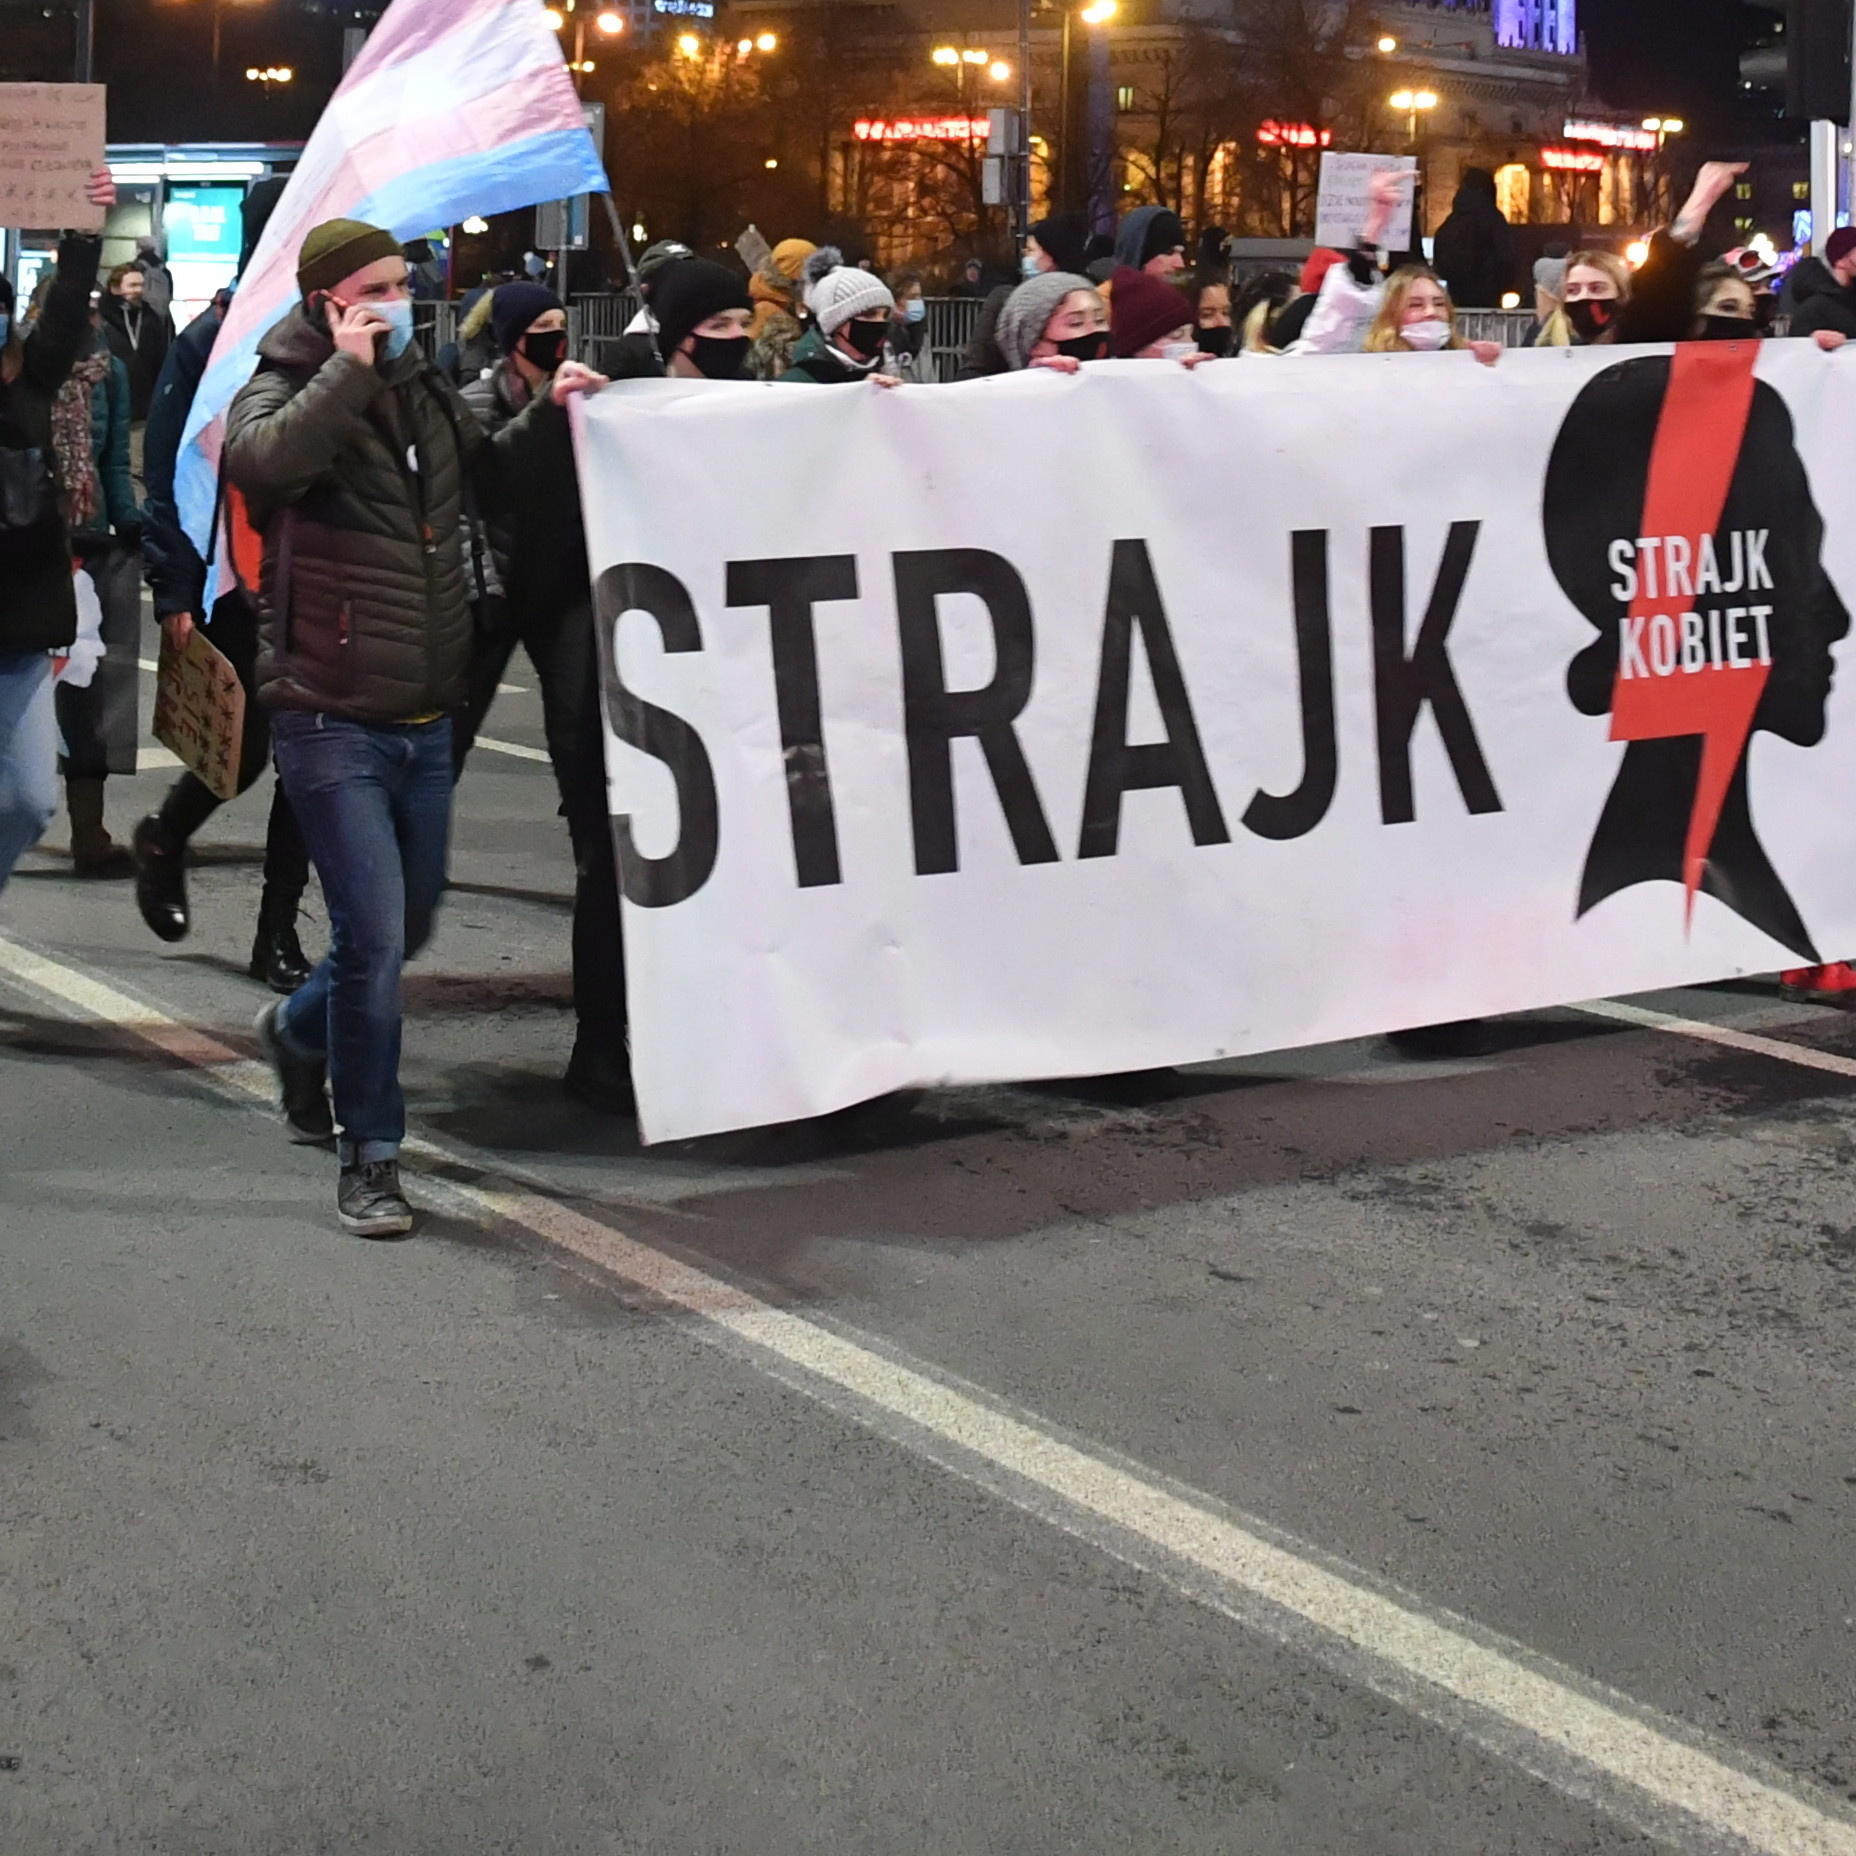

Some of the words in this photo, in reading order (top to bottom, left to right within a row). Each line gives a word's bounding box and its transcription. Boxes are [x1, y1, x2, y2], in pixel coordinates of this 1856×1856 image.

[1608, 528, 1775, 603] STRAJK
[1618, 604, 1773, 681] KOBIET
[595, 520, 1504, 908] STRAJK
